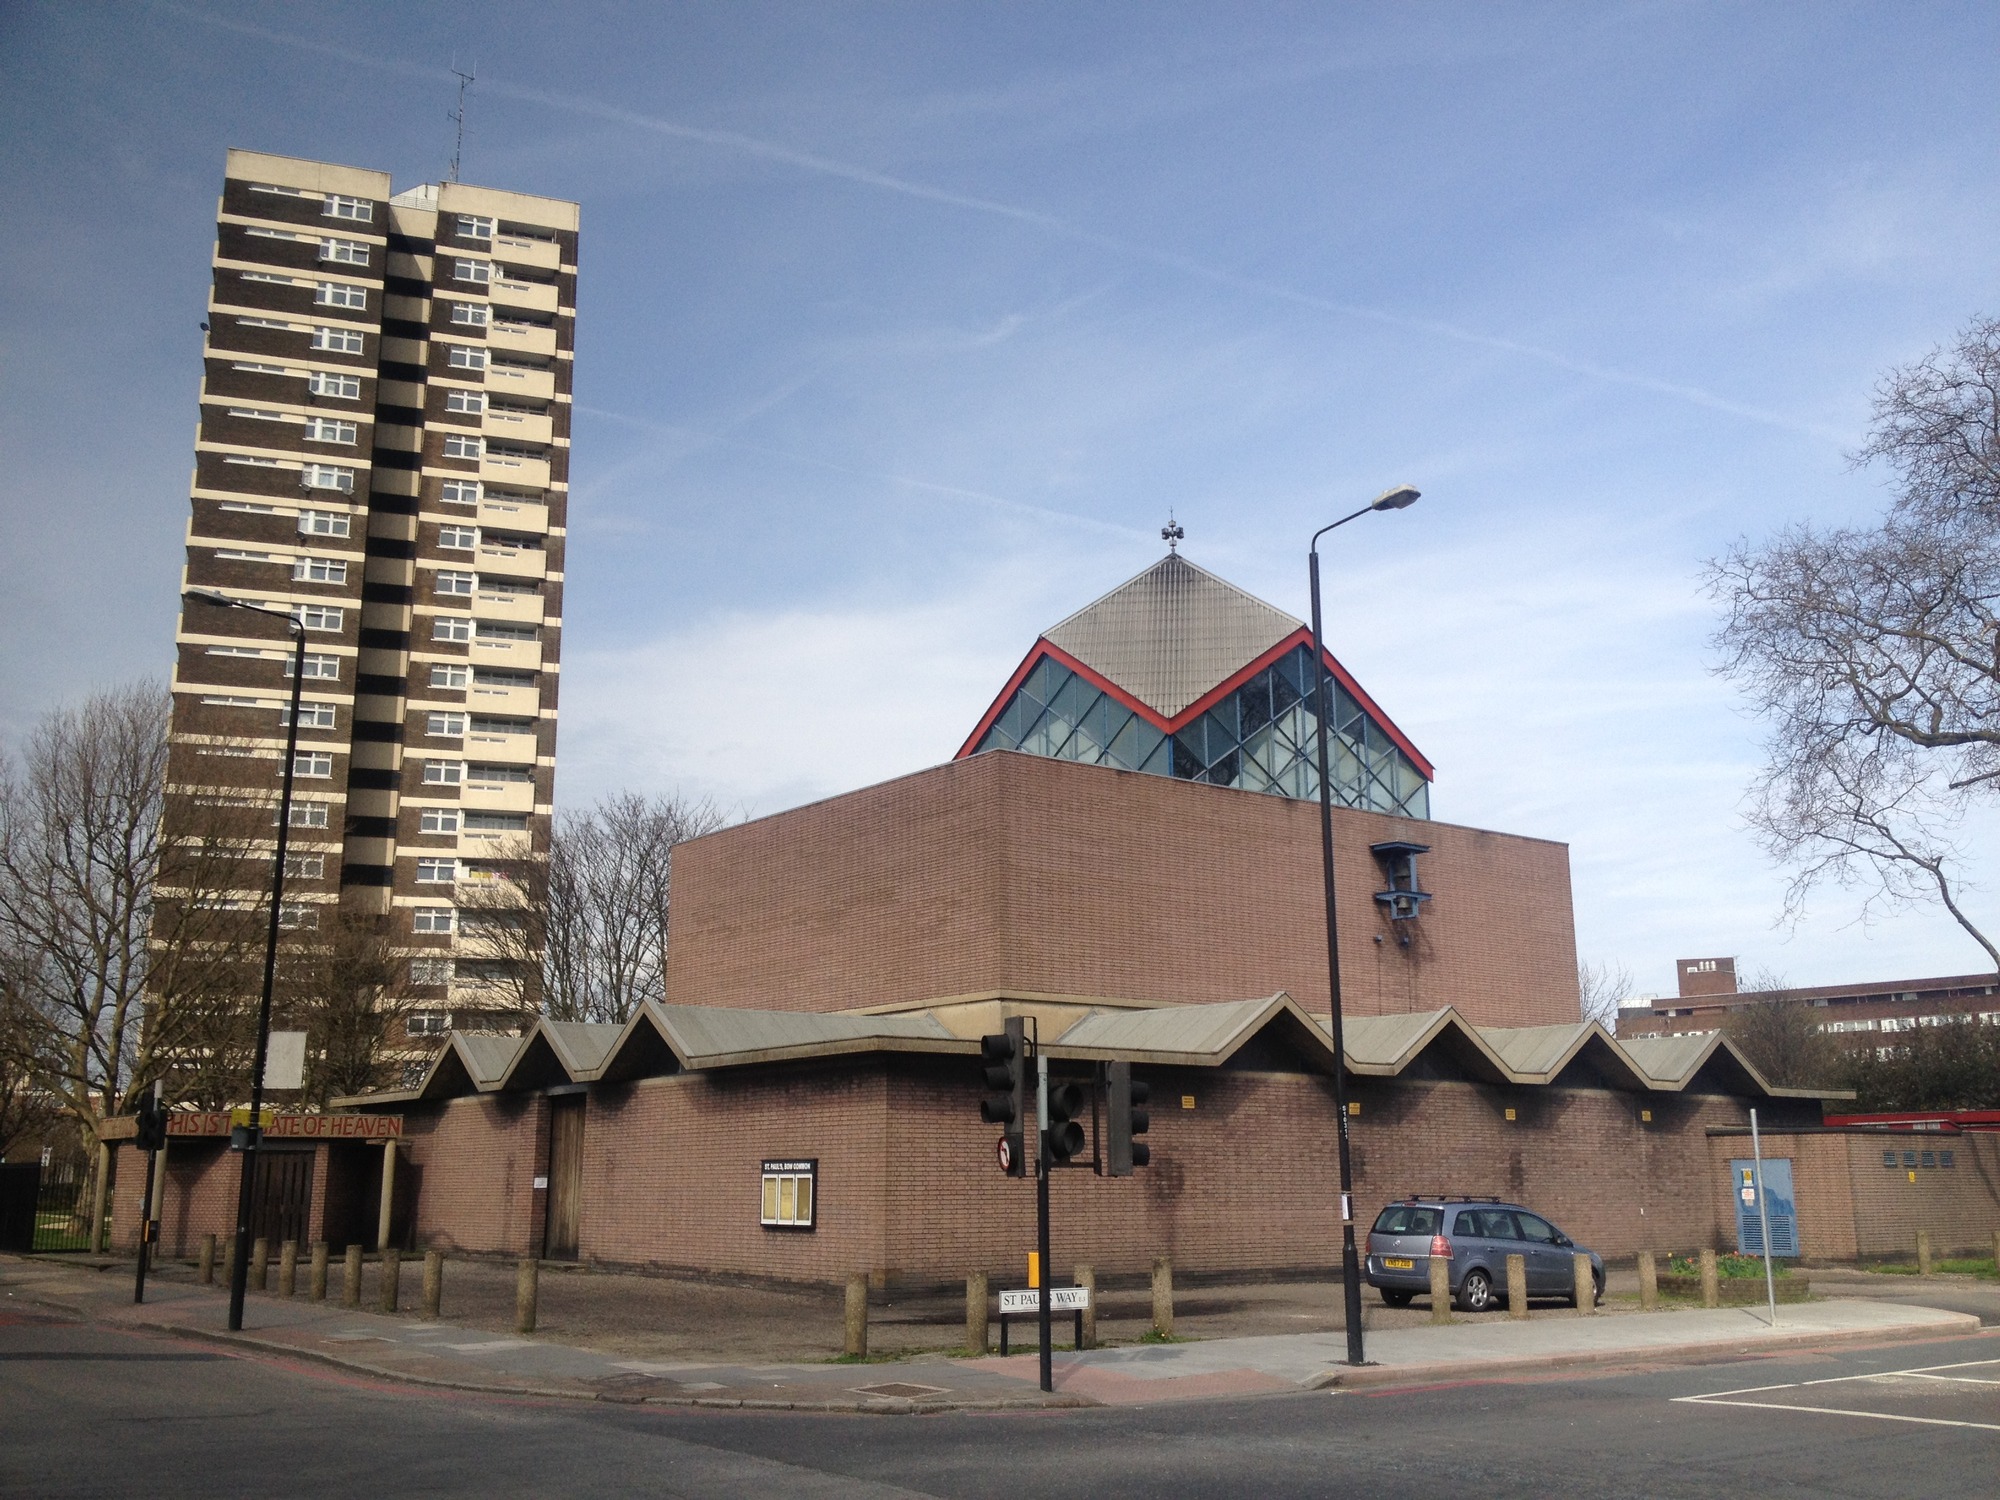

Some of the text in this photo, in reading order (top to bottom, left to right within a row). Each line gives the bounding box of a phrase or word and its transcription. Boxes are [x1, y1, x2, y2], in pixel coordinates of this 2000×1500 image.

[168, 1114, 200, 1134] HIS
[204, 1115, 219, 1134] IS
[304, 1116, 328, 1135] OF
[331, 1117, 401, 1136] HEAVEN
[1004, 1295, 1016, 1306] ST
[1056, 1292, 1078, 1303] WAY
